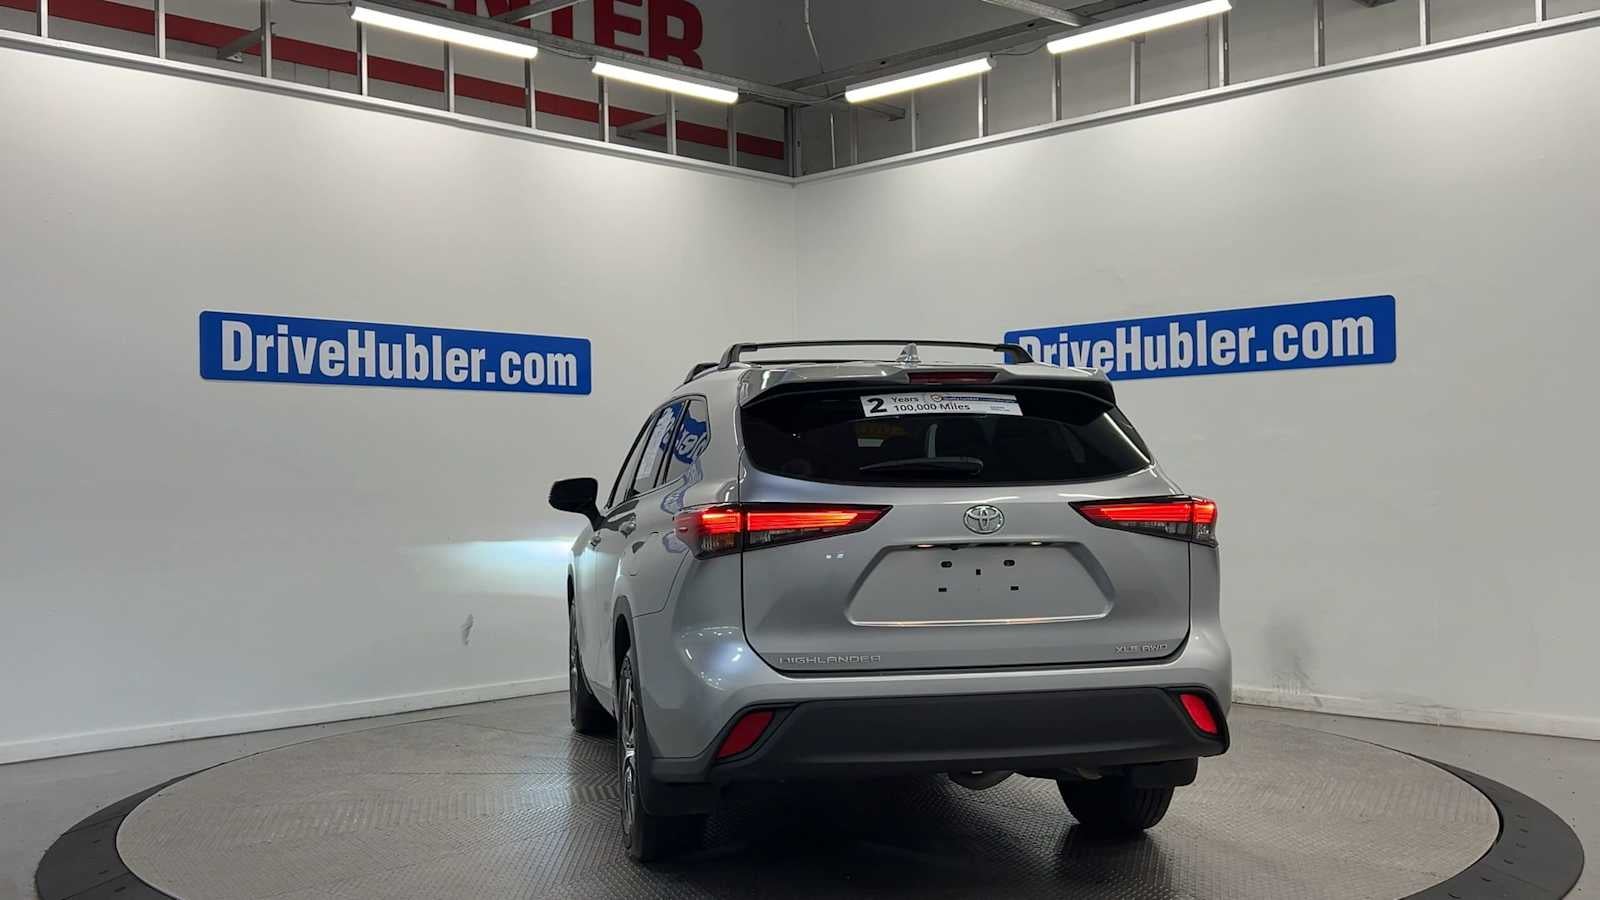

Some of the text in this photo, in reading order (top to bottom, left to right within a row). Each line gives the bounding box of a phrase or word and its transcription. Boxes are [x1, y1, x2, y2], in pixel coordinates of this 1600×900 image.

[1018, 315, 1375, 373] DriveHubler.com
[221, 320, 577, 387] DriveHubler.com
[867, 397, 888, 413] 2
[895, 401, 971, 412] 100,000 Miles
[777, 655, 881, 665] HIGHLANDER
